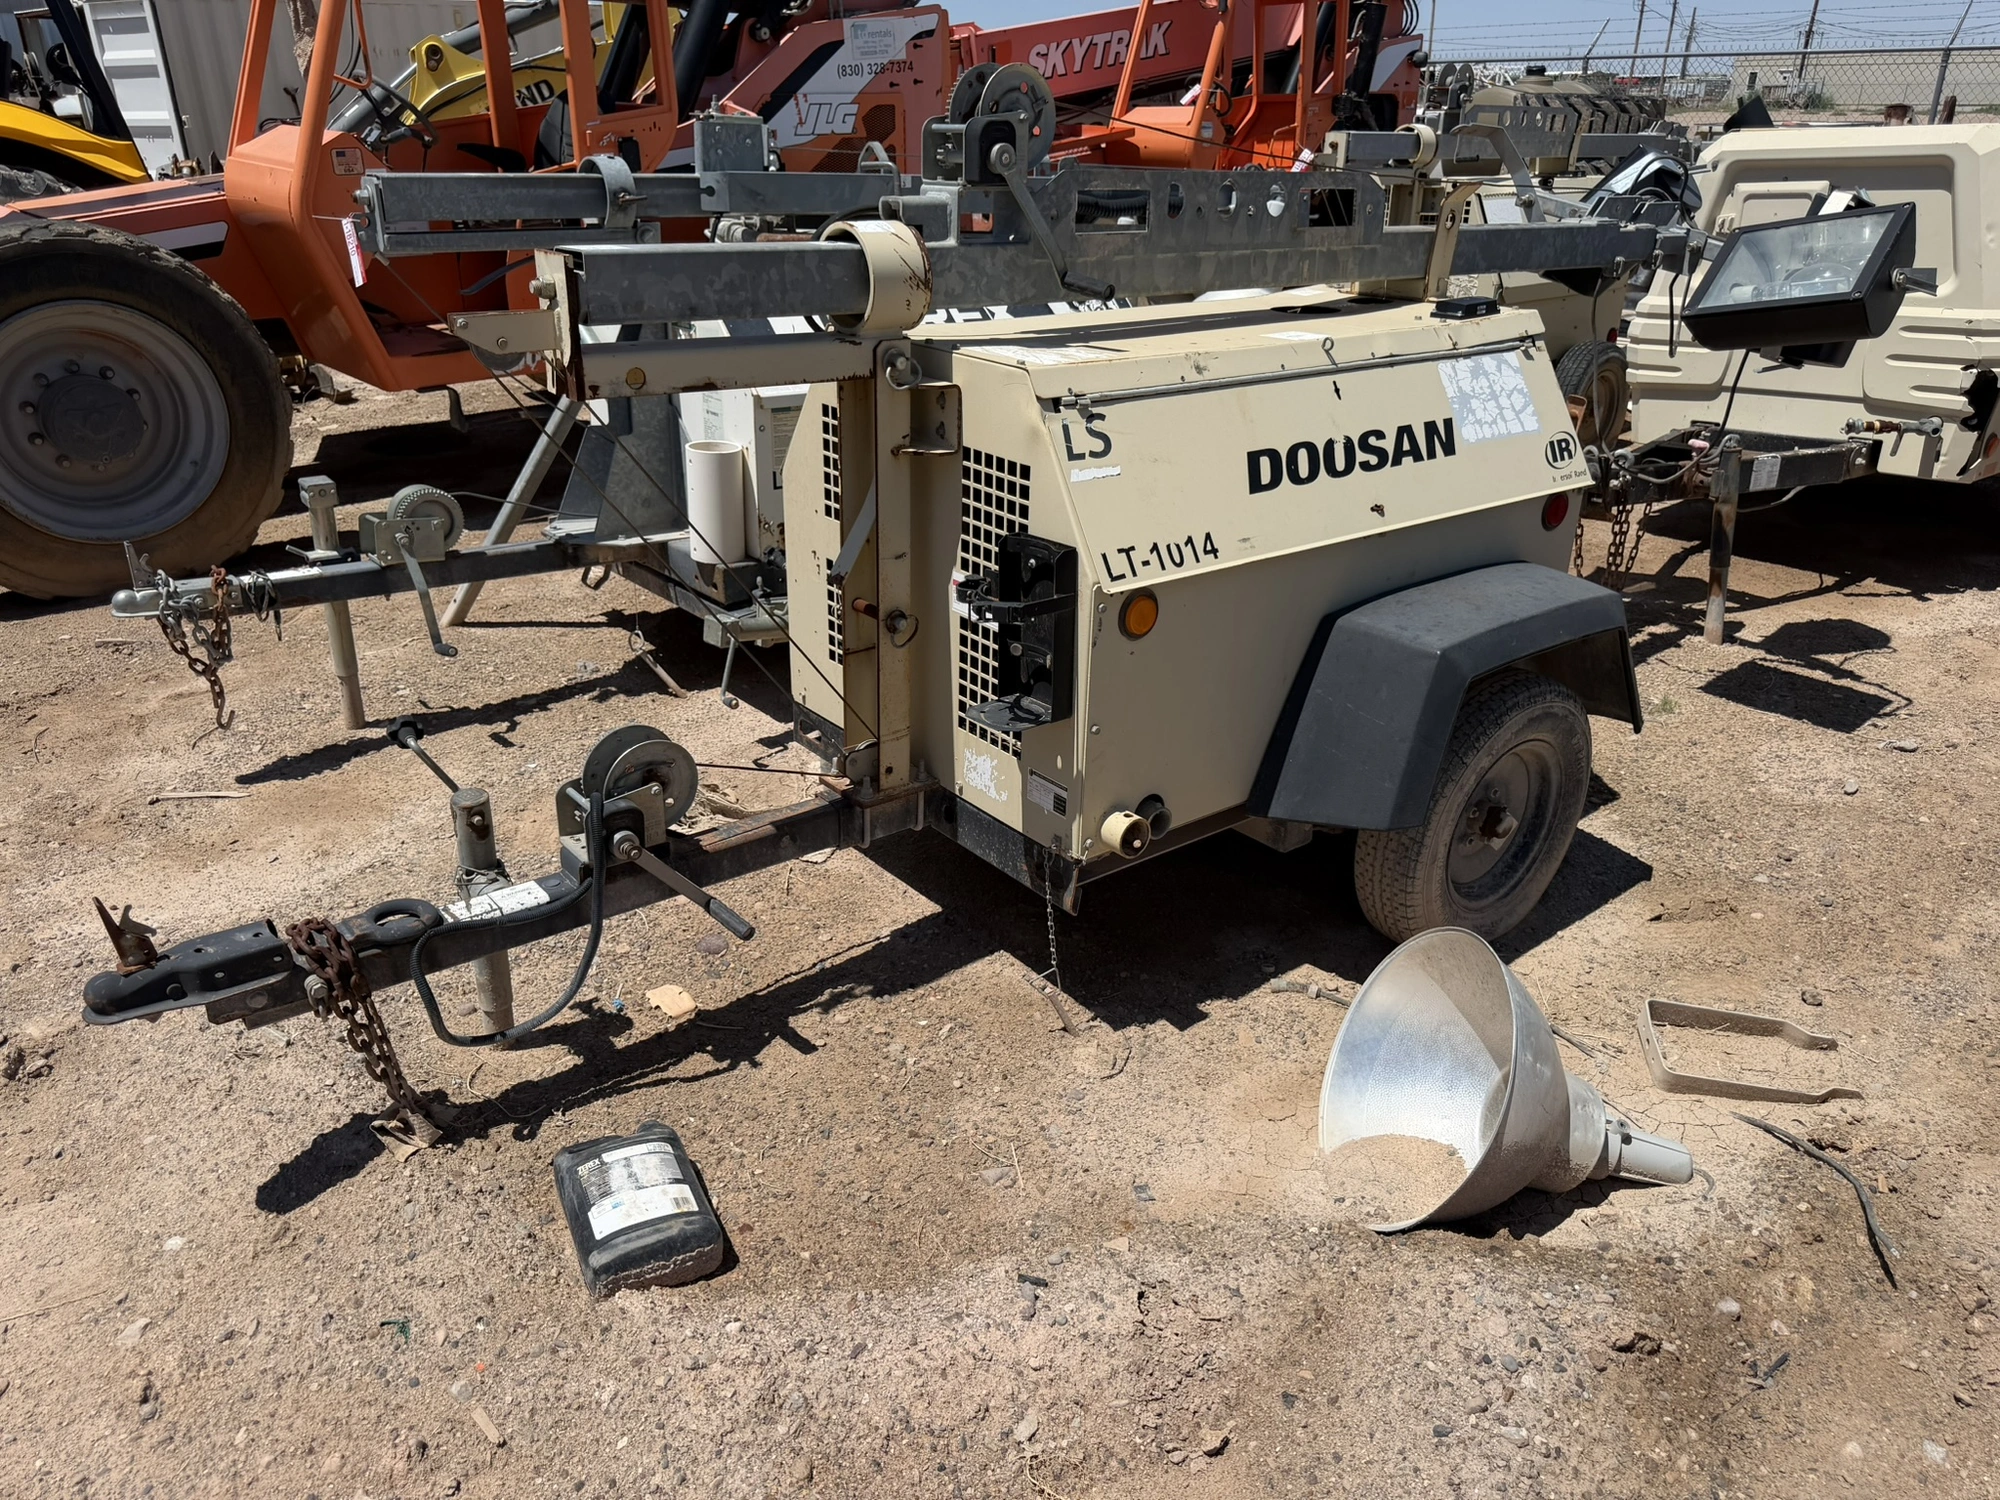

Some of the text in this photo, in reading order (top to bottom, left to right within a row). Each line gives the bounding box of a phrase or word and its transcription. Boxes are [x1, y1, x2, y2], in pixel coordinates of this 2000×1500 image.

[837, 60, 914, 79] (830) 328-7374
[794, 103, 860, 136] JLG
[1061, 412, 1112, 462] LS
[1247, 417, 1456, 495] DOOSAN
[1548, 437, 1574, 464] IR
[1100, 531, 1220, 582] LT-1014
